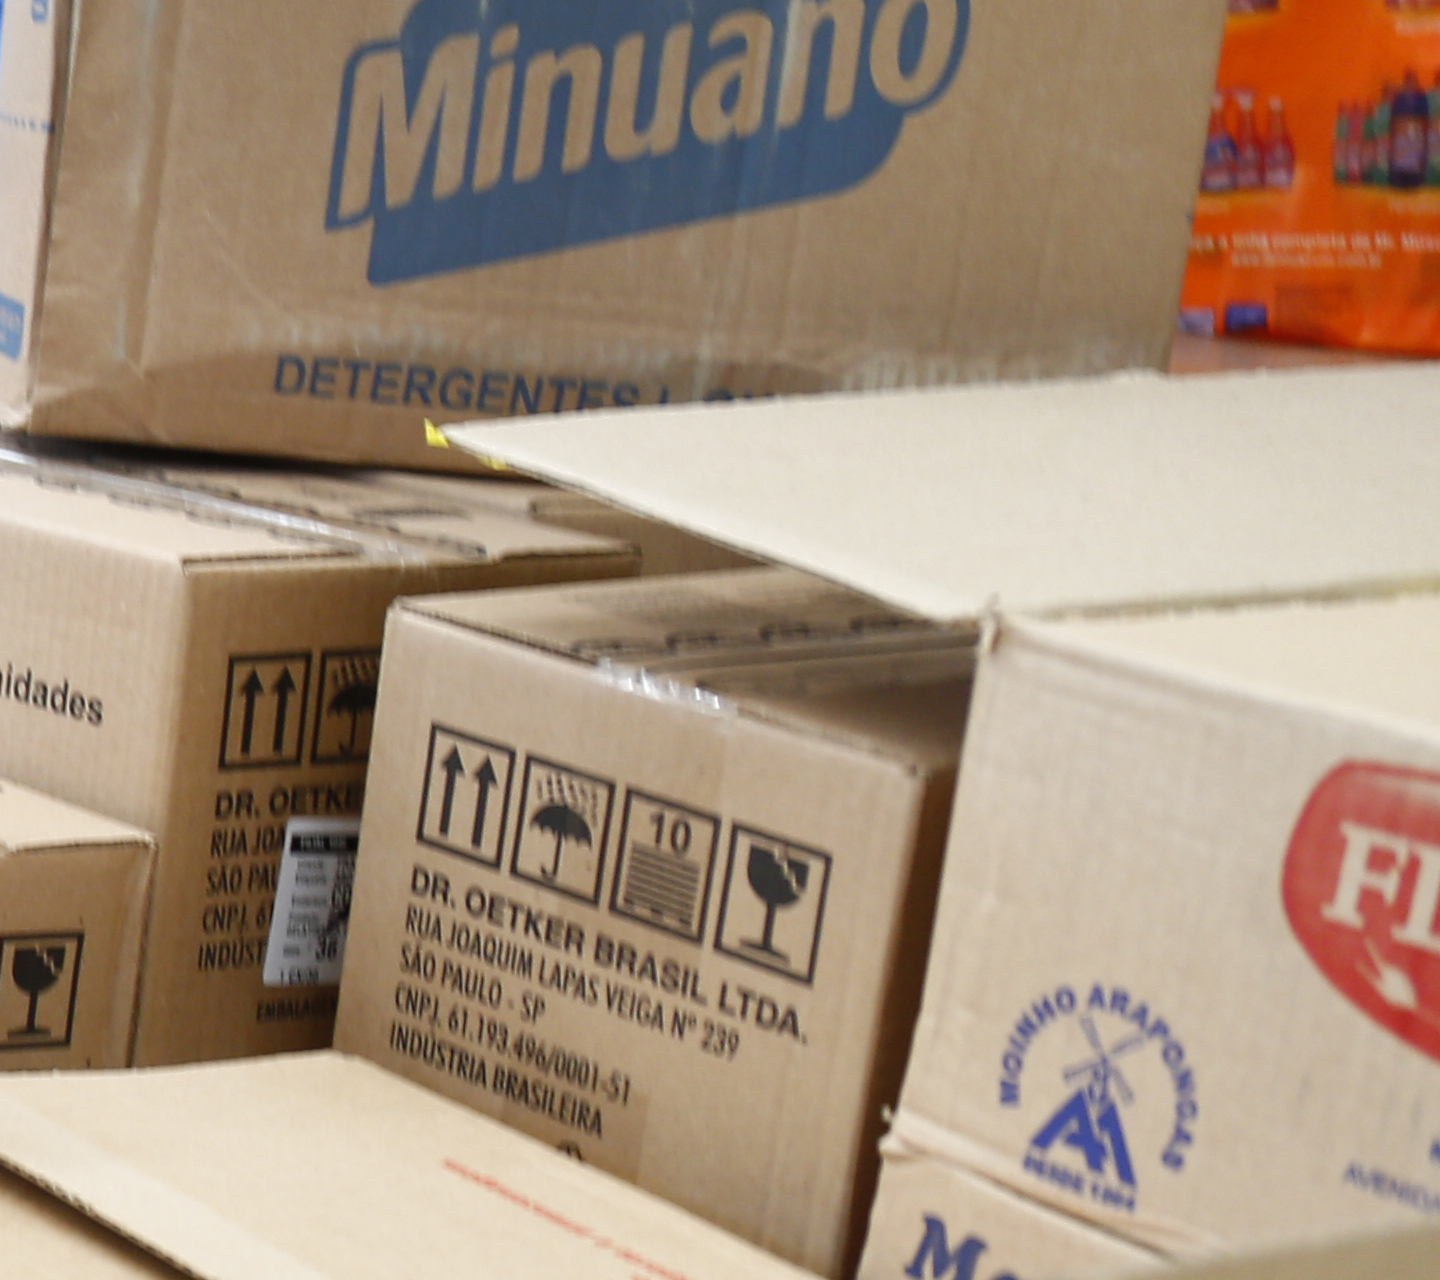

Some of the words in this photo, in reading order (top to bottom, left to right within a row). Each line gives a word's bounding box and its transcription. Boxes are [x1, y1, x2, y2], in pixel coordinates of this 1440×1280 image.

[274, 354, 641, 417] DETERGENTES
[215, 790, 260, 819] DR.
[650, 811, 693, 855] 10
[211, 827, 248, 858] RUA
[206, 863, 243, 896] SÃO
[399, 943, 438, 981] SÃO
[440, 964, 503, 1011] PAULO
[519, 991, 547, 1025] SP
[404, 905, 444, 944] RUA
[446, 923, 534, 977] JOAQUIM
[538, 956, 599, 1007] LAPAS
[605, 982, 666, 1033] VEIGA
[701, 1018, 741, 1061] 239
[411, 864, 457, 912] DR.
[464, 888, 586, 958] OETKER
[593, 932, 708, 1008] BRASIL
[717, 980, 809, 1046] LTDA.
[394, 982, 443, 1027] CNPJ.
[389, 1018, 488, 1086] INDÚSTRIA
[492, 1062, 604, 1139] BRASILEIRA
[999, 984, 1078, 1108] MOINHO
[1087, 981, 1199, 1173] ARAPONGAS
